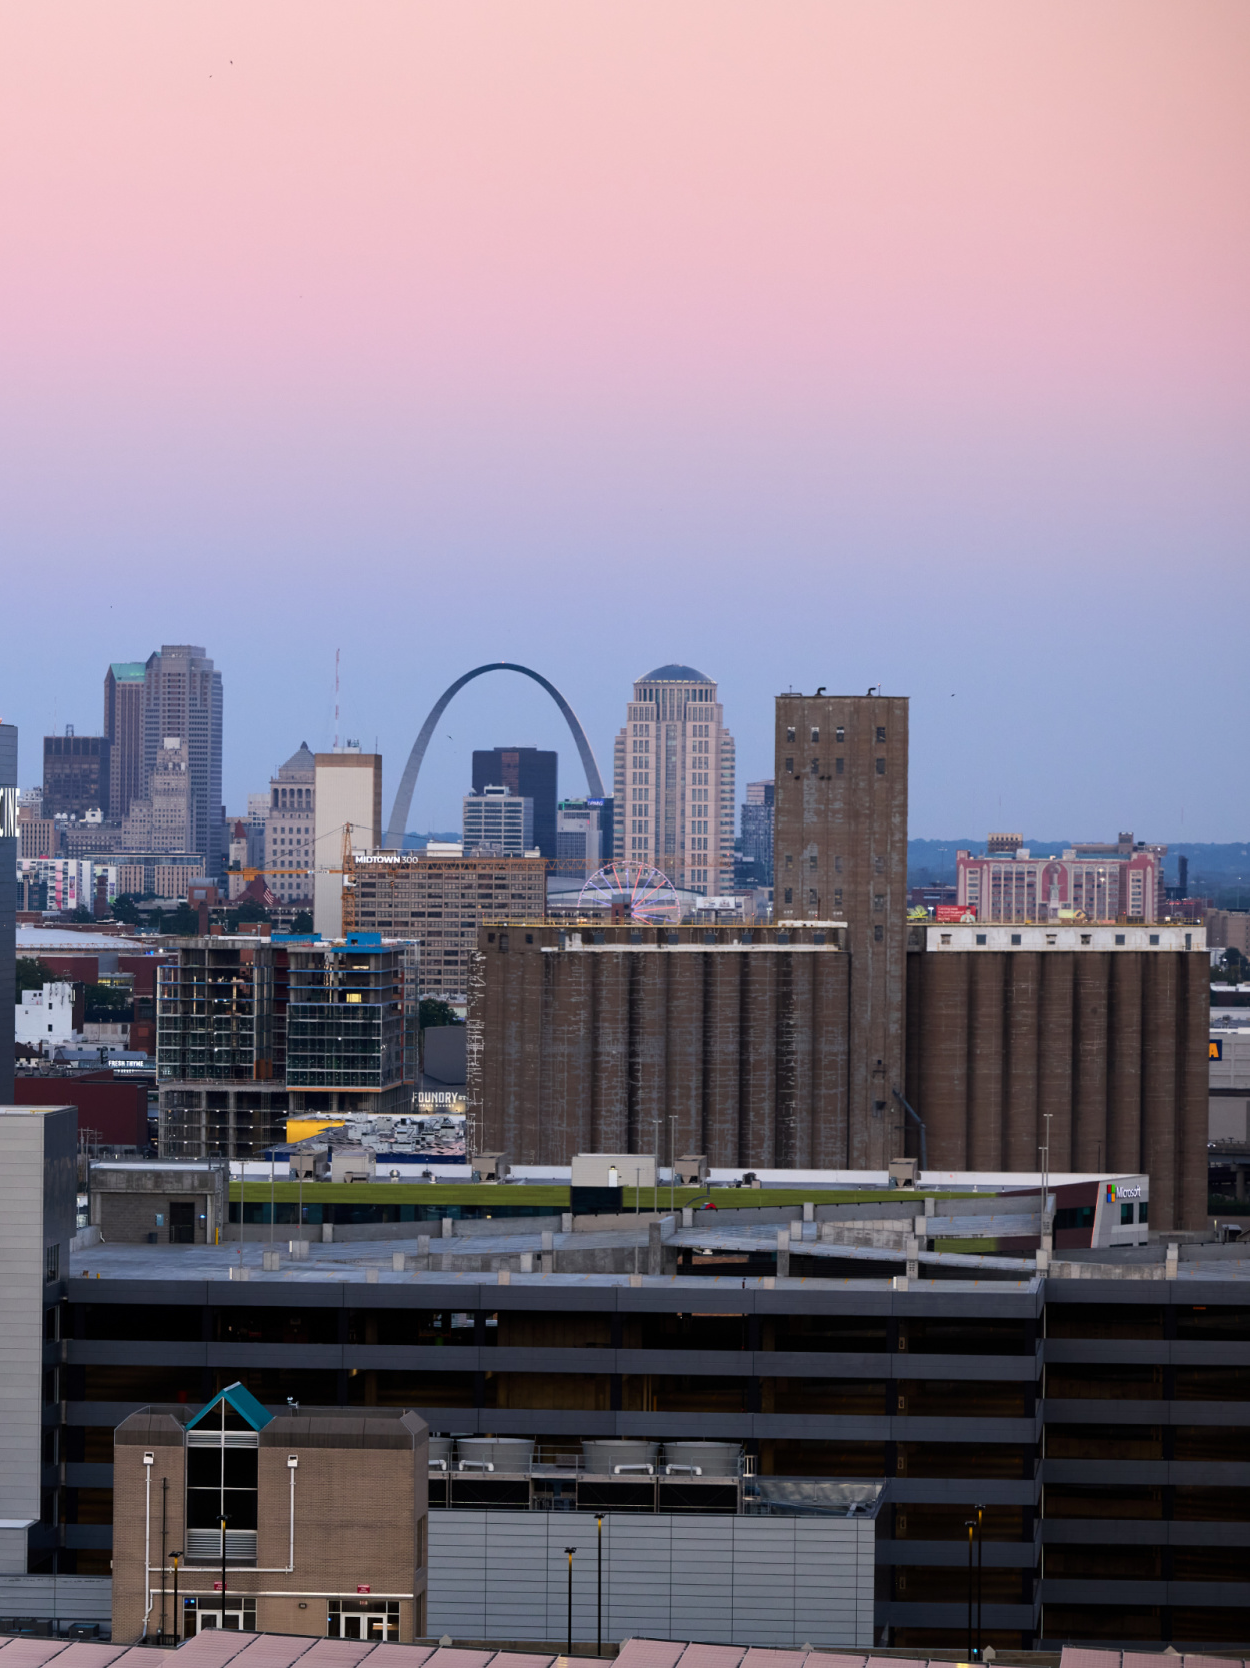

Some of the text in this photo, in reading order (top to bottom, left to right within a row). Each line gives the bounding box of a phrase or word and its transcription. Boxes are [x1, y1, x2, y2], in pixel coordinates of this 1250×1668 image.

[355, 856, 419, 864] MIDTOWN 300
[412, 1091, 458, 1103] FOUNDRY
[1116, 1185, 1141, 1198] Microsoft
